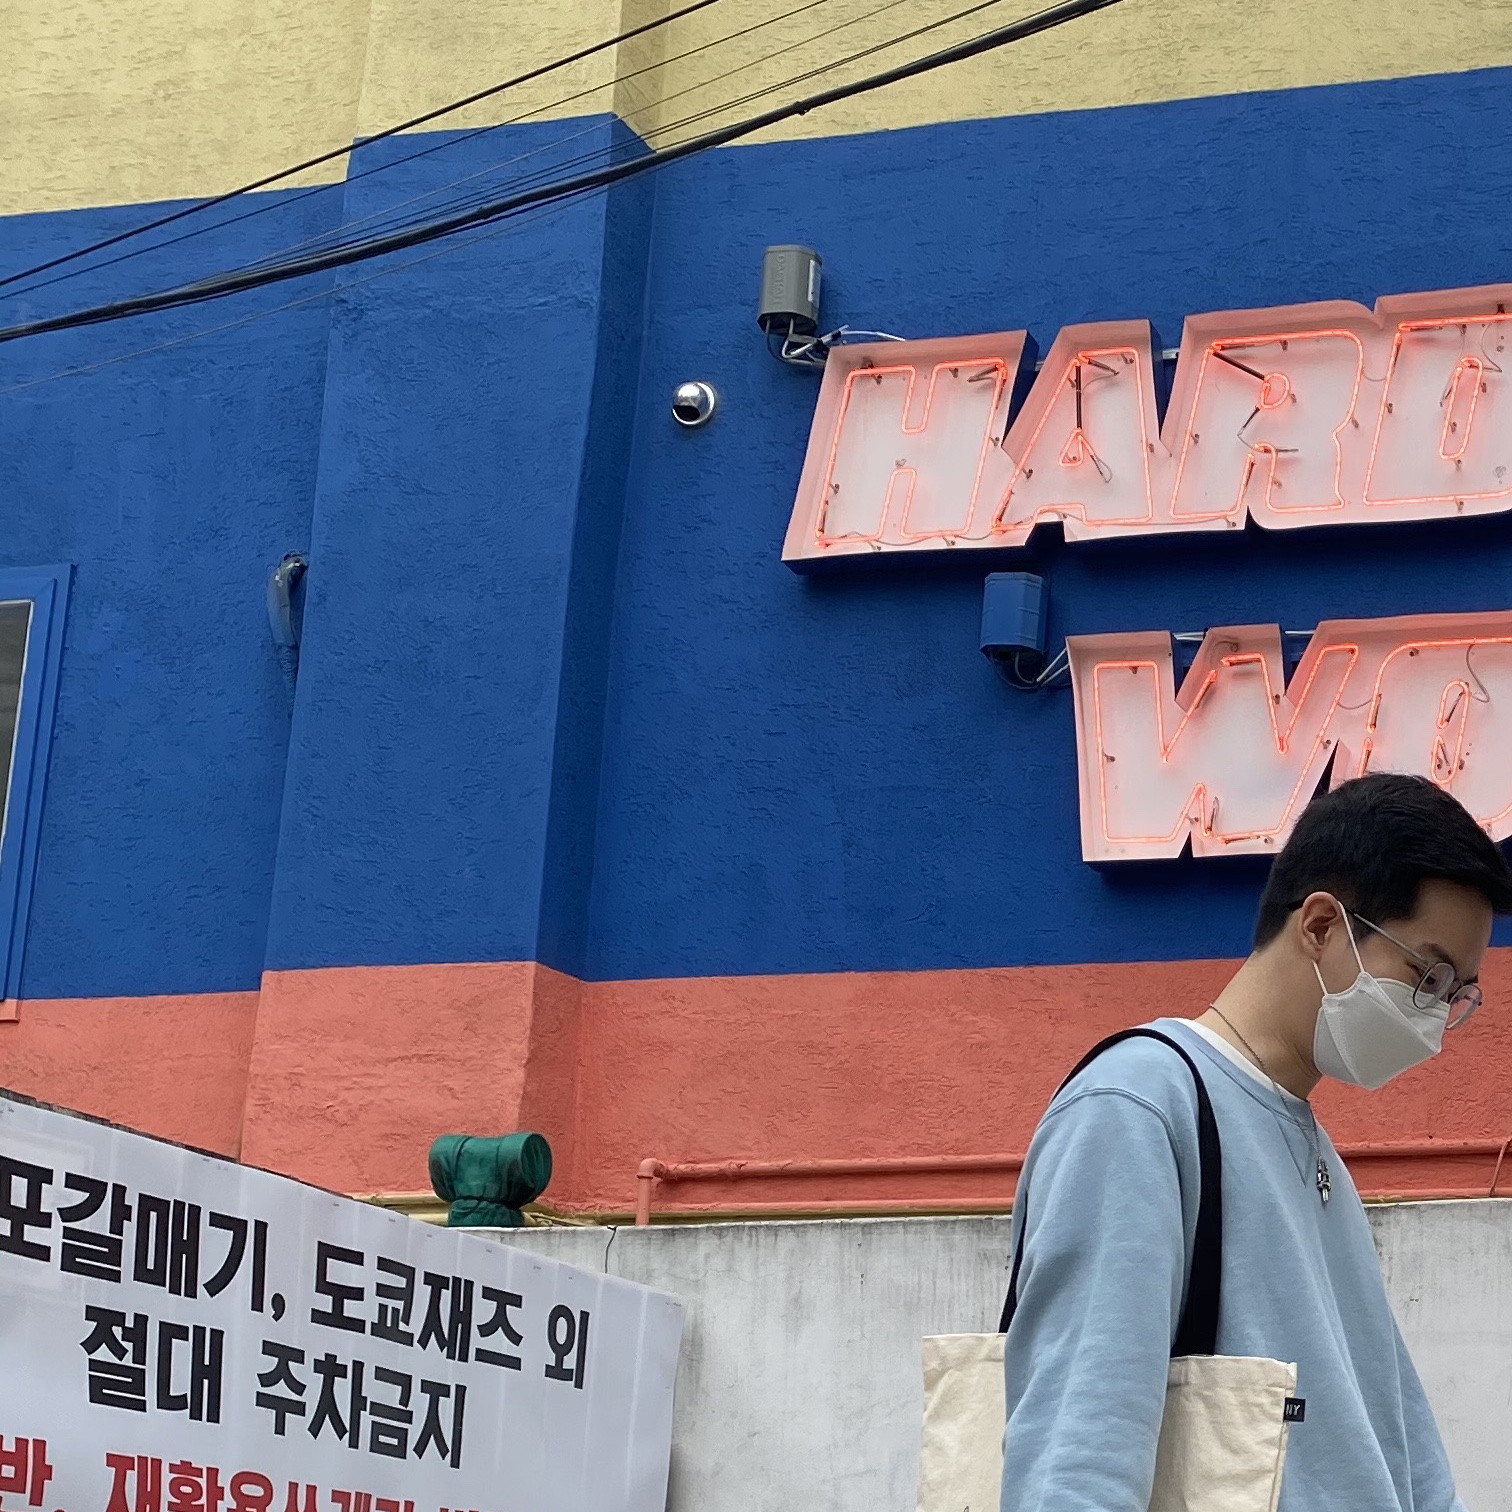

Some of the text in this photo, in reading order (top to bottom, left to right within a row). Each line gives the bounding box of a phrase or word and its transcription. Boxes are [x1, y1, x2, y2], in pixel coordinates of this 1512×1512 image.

[80, 1305, 468, 1469] 절대 주차금지
[310, 1241, 524, 1372] 도쿄재즈
[544, 1303, 590, 1390] 외
